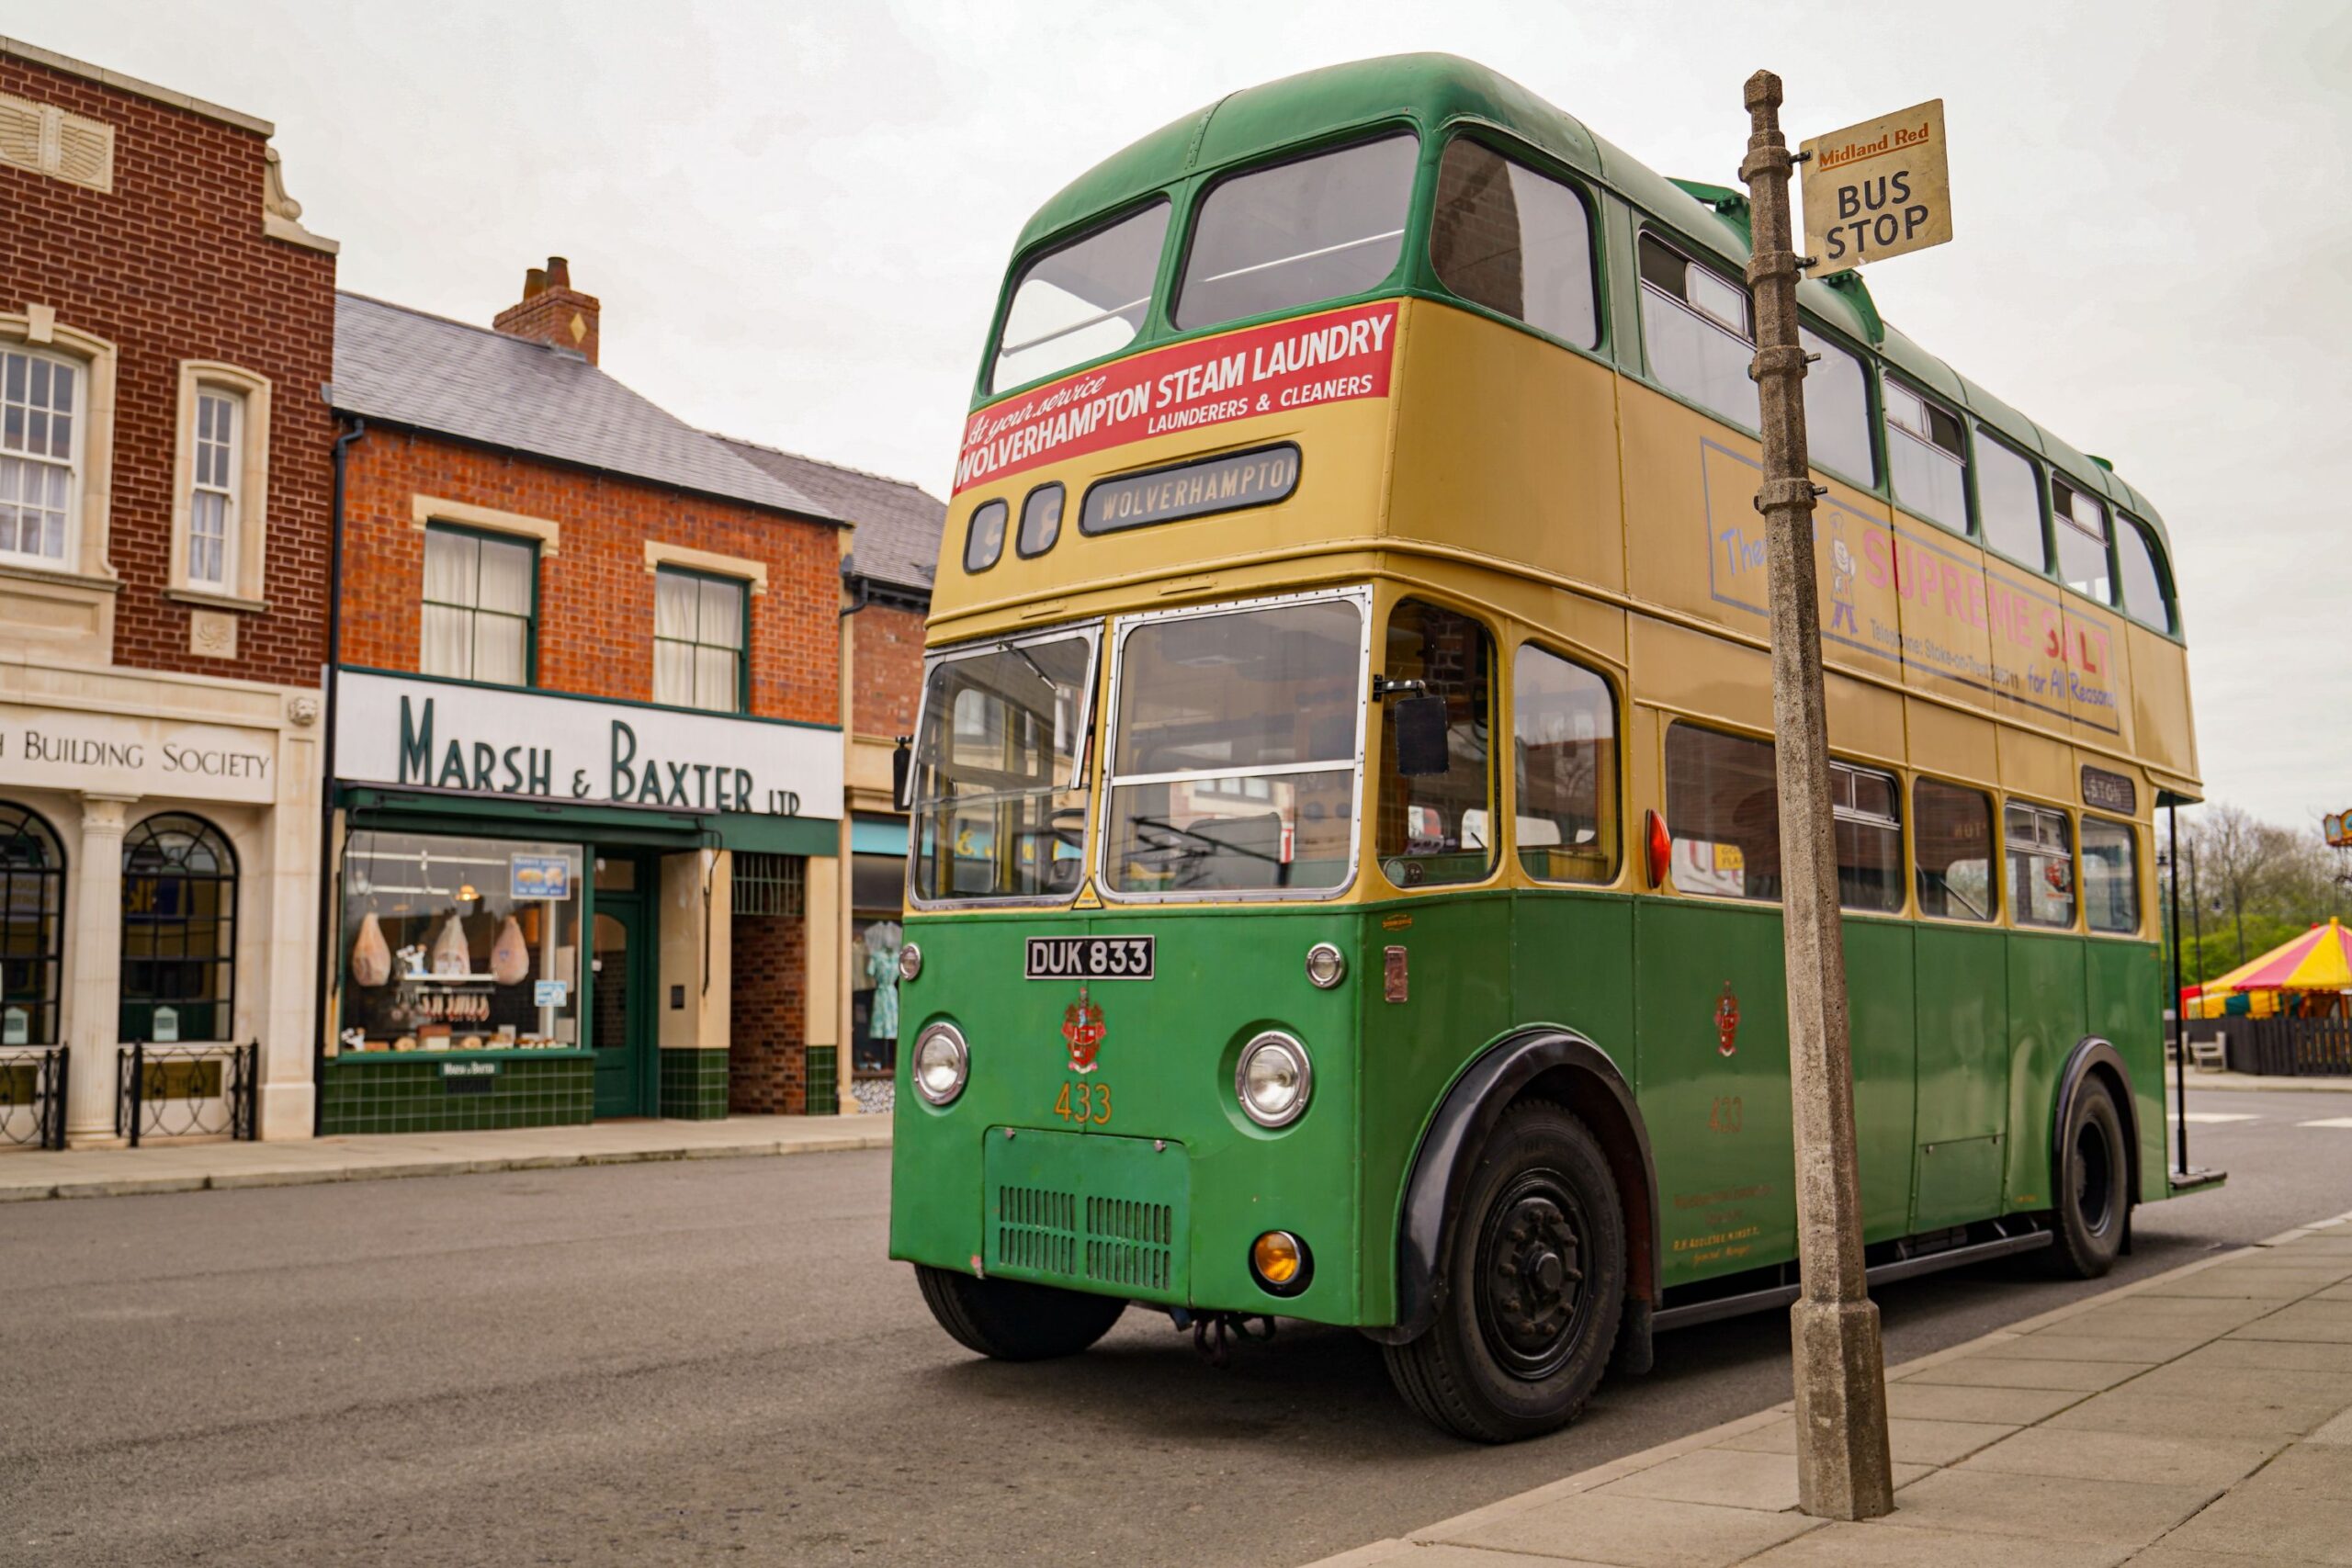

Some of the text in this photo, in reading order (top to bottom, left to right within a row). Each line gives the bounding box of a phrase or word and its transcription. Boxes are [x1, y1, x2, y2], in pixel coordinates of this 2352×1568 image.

[1819, 122, 1929, 167] Midland Red
[1838, 170, 1911, 220] BUS
[1826, 204, 1928, 260] STOP
[956, 314, 1393, 488] WOLVERHAMPTON STEAM LAUNDRY
[963, 374, 1107, 449] At your service
[1148, 374, 1374, 434] LAUNDERERS & CLEANERS
[1720, 527, 1765, 577] The
[1863, 528, 2109, 681] SUPREME SALT
[2028, 663, 2047, 694] for
[2051, 667, 2065, 699] All
[24, 730, 144, 770] BUILDING
[162, 742, 270, 779] SOCIETY
[398, 694, 800, 816] MARSH & BAXTER LTD
[1031, 941, 1148, 975] DUK 833
[1054, 1081, 1112, 1126] 433
